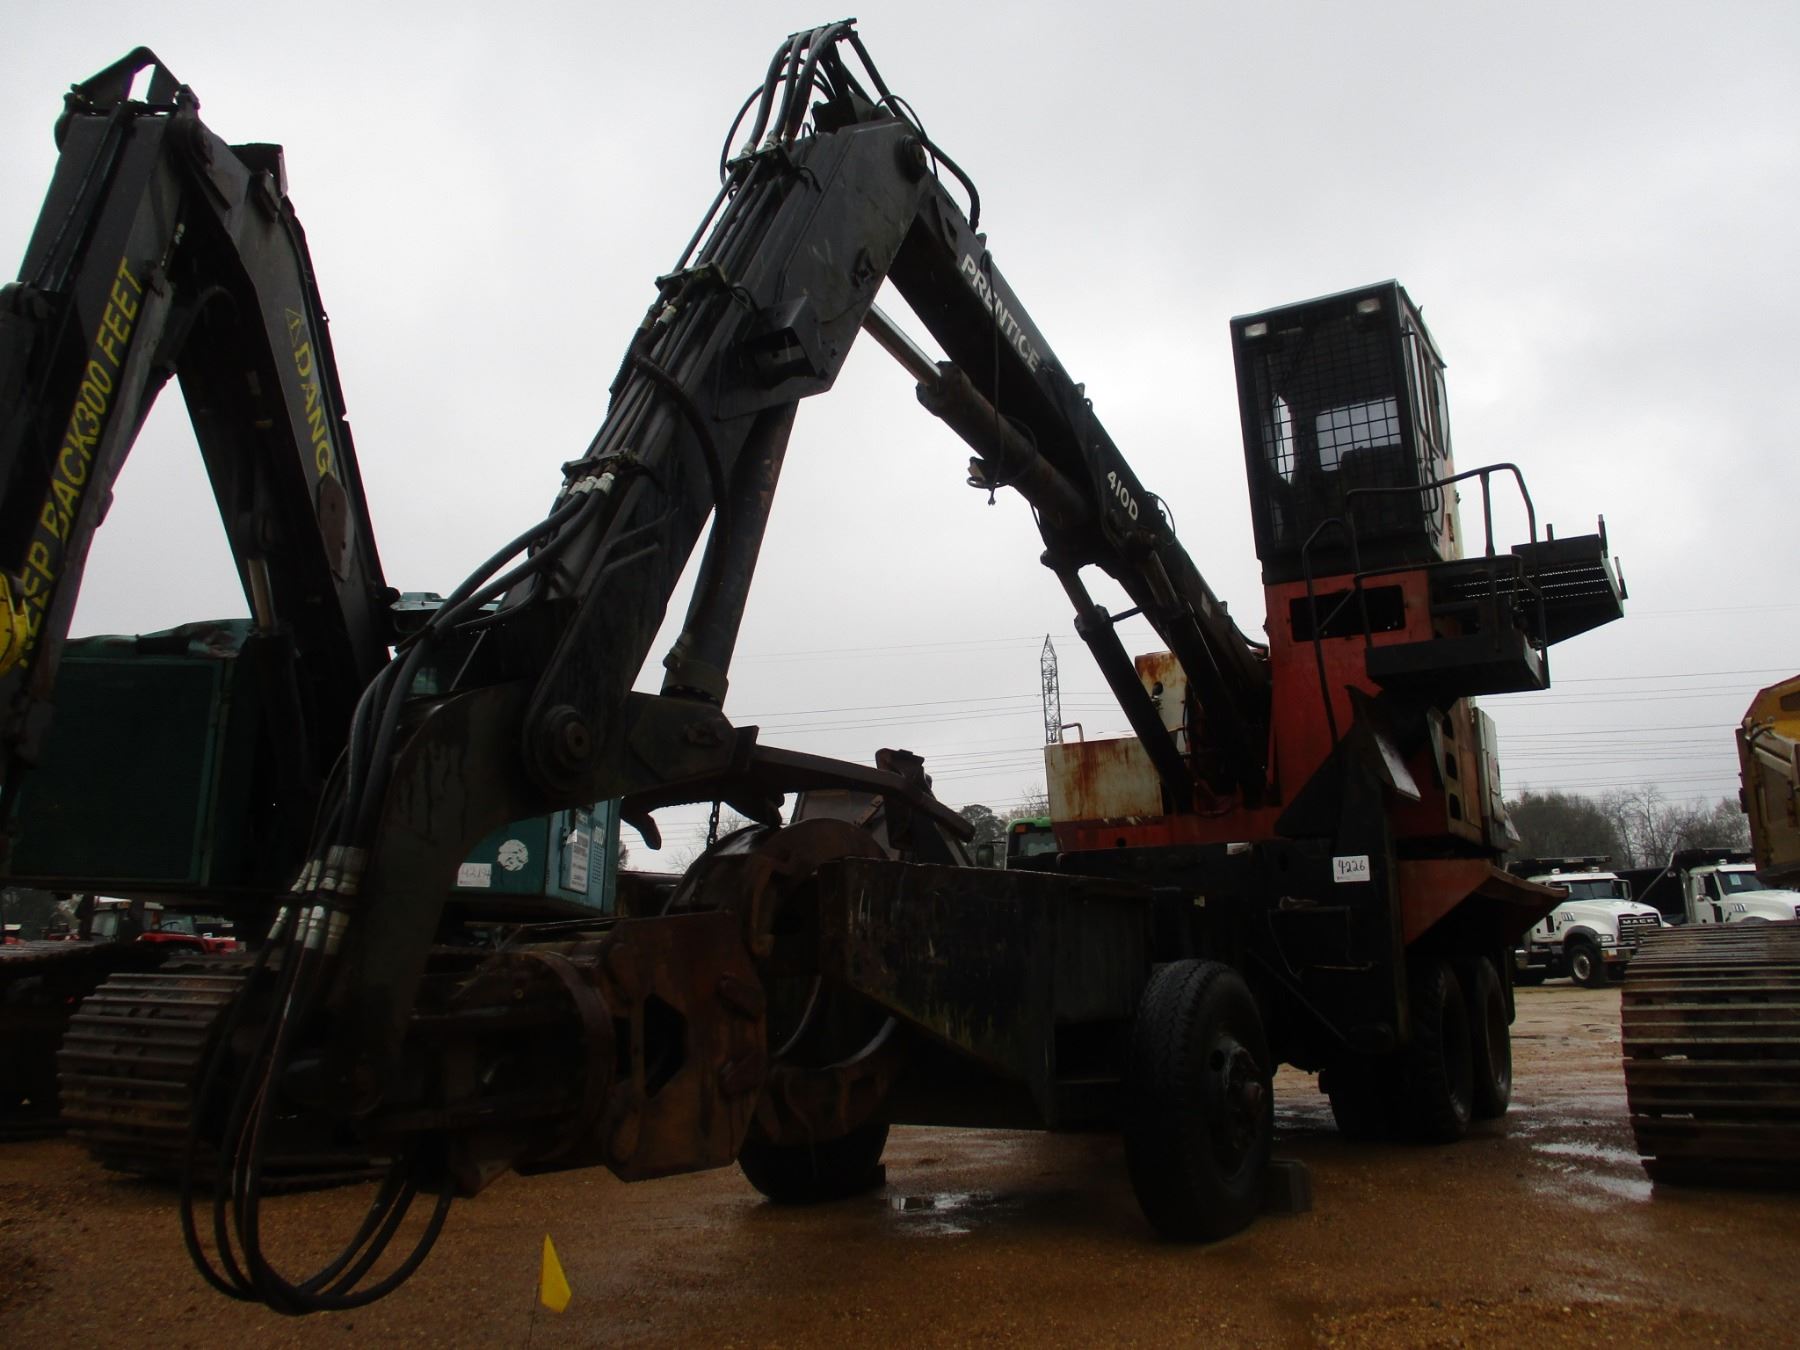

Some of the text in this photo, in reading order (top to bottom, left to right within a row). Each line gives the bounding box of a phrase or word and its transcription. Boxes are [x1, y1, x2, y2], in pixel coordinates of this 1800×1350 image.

[97, 256, 142, 368] FEET
[961, 253, 1040, 373] PRENTICE
[295, 341, 335, 477] DANG
[1107, 471, 1139, 520] 410D
[1338, 859, 1366, 874] 4226
